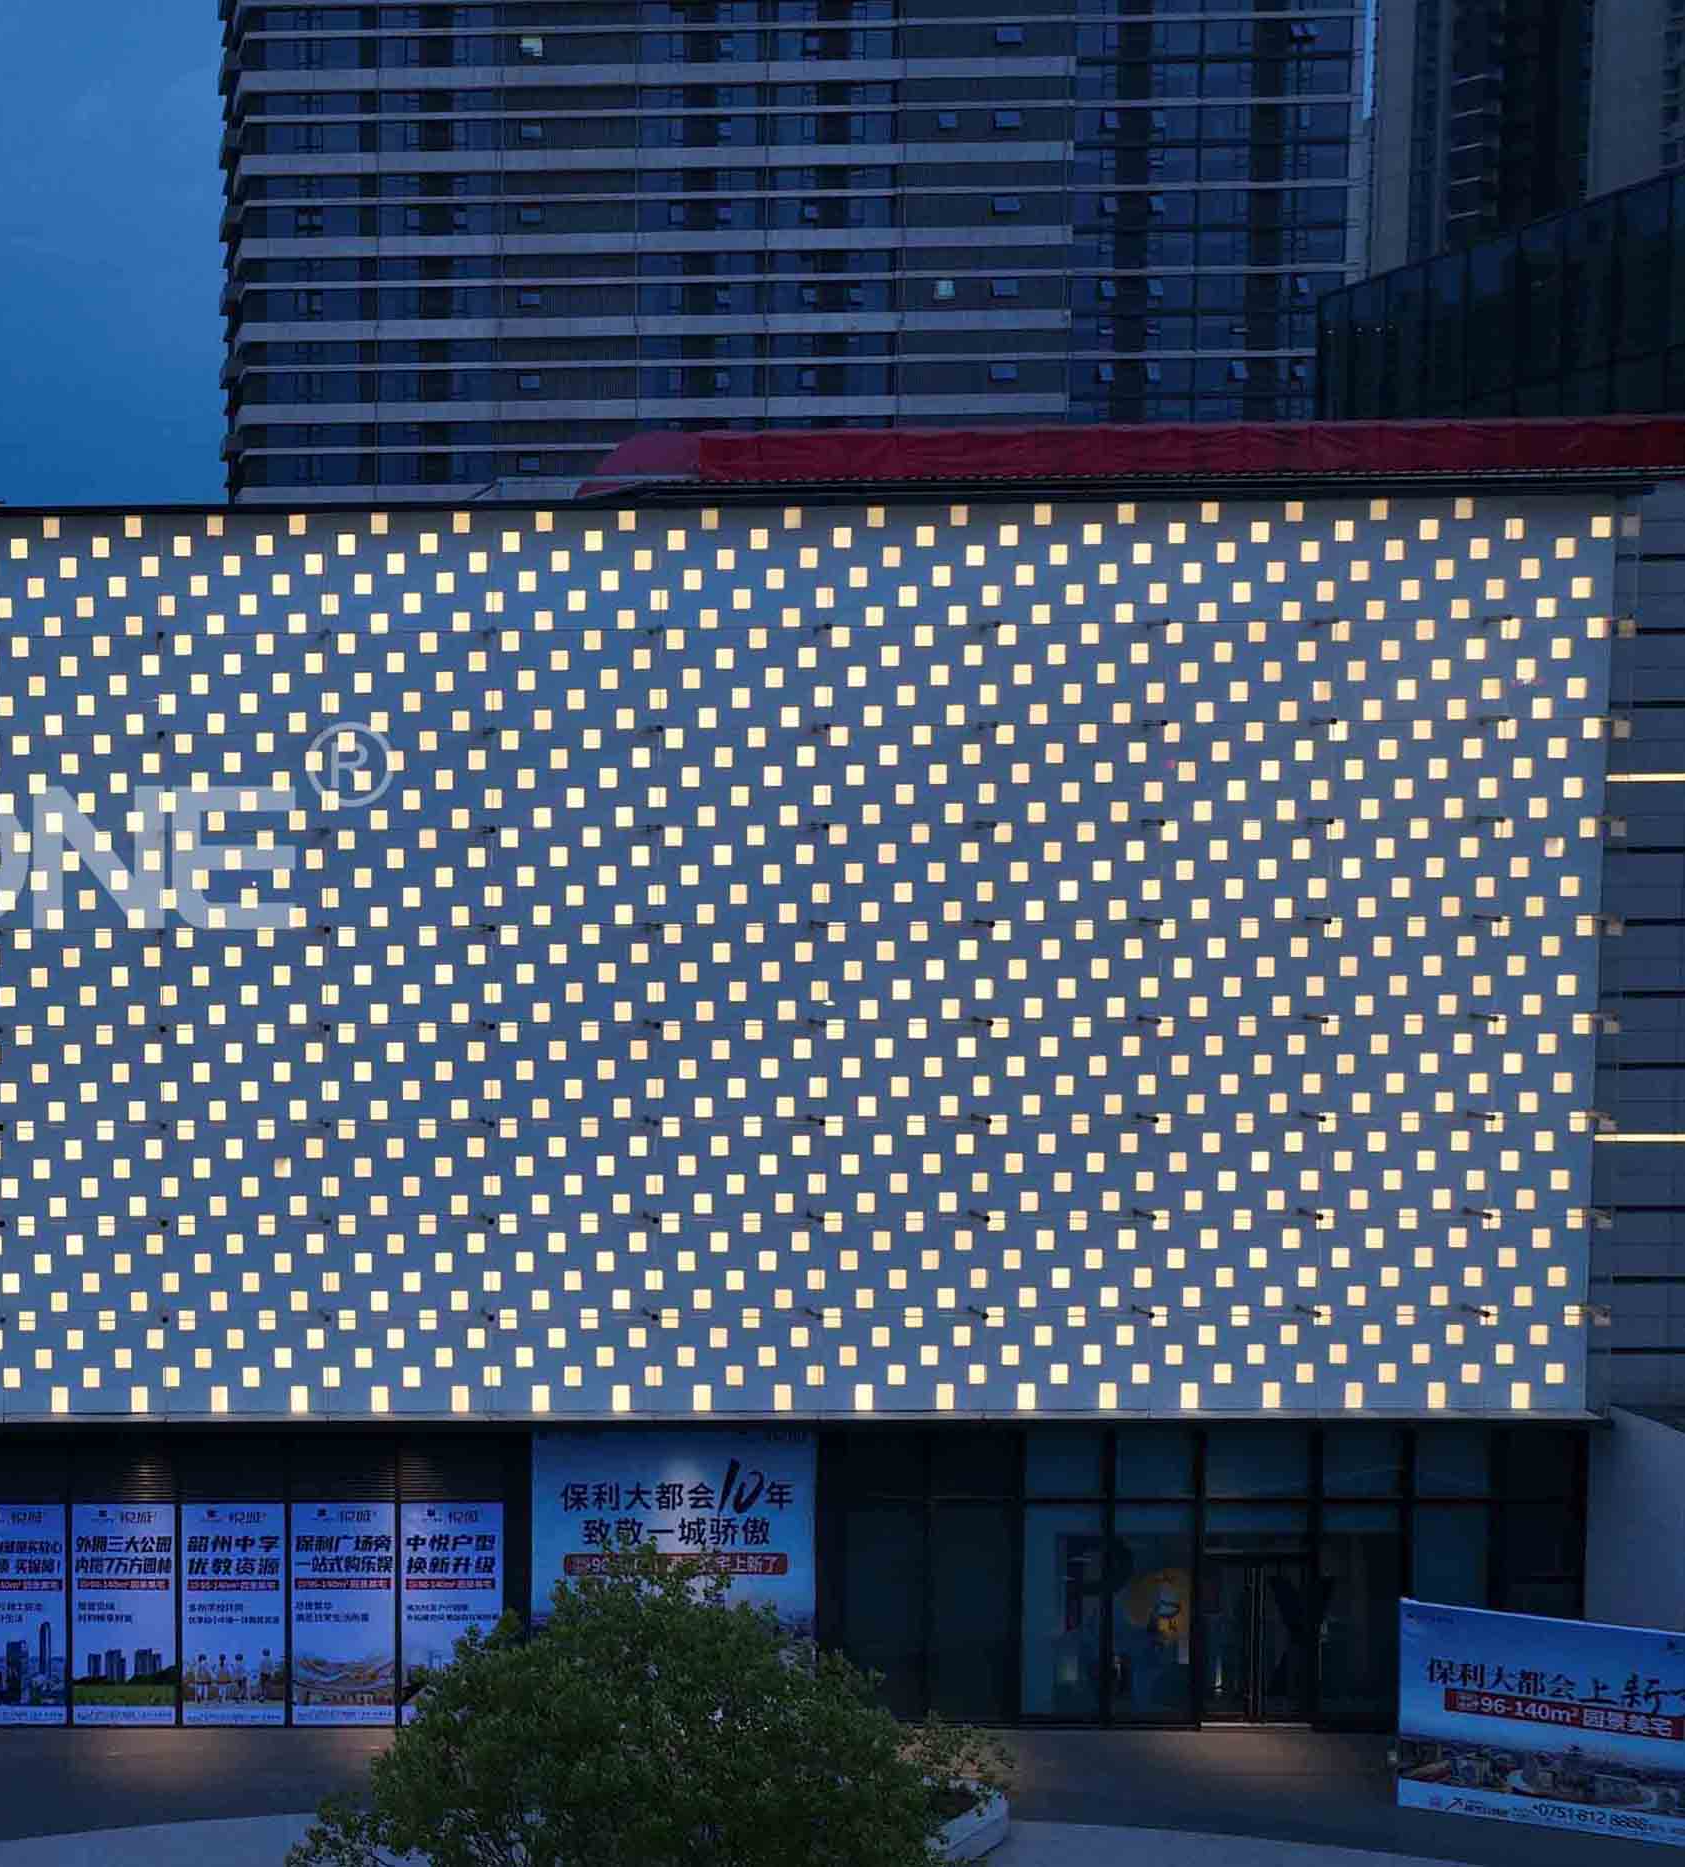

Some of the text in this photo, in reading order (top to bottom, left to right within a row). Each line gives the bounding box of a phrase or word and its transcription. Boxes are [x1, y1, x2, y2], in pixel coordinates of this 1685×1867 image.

[583, 1516, 771, 1547] 致敬一城骄傲
